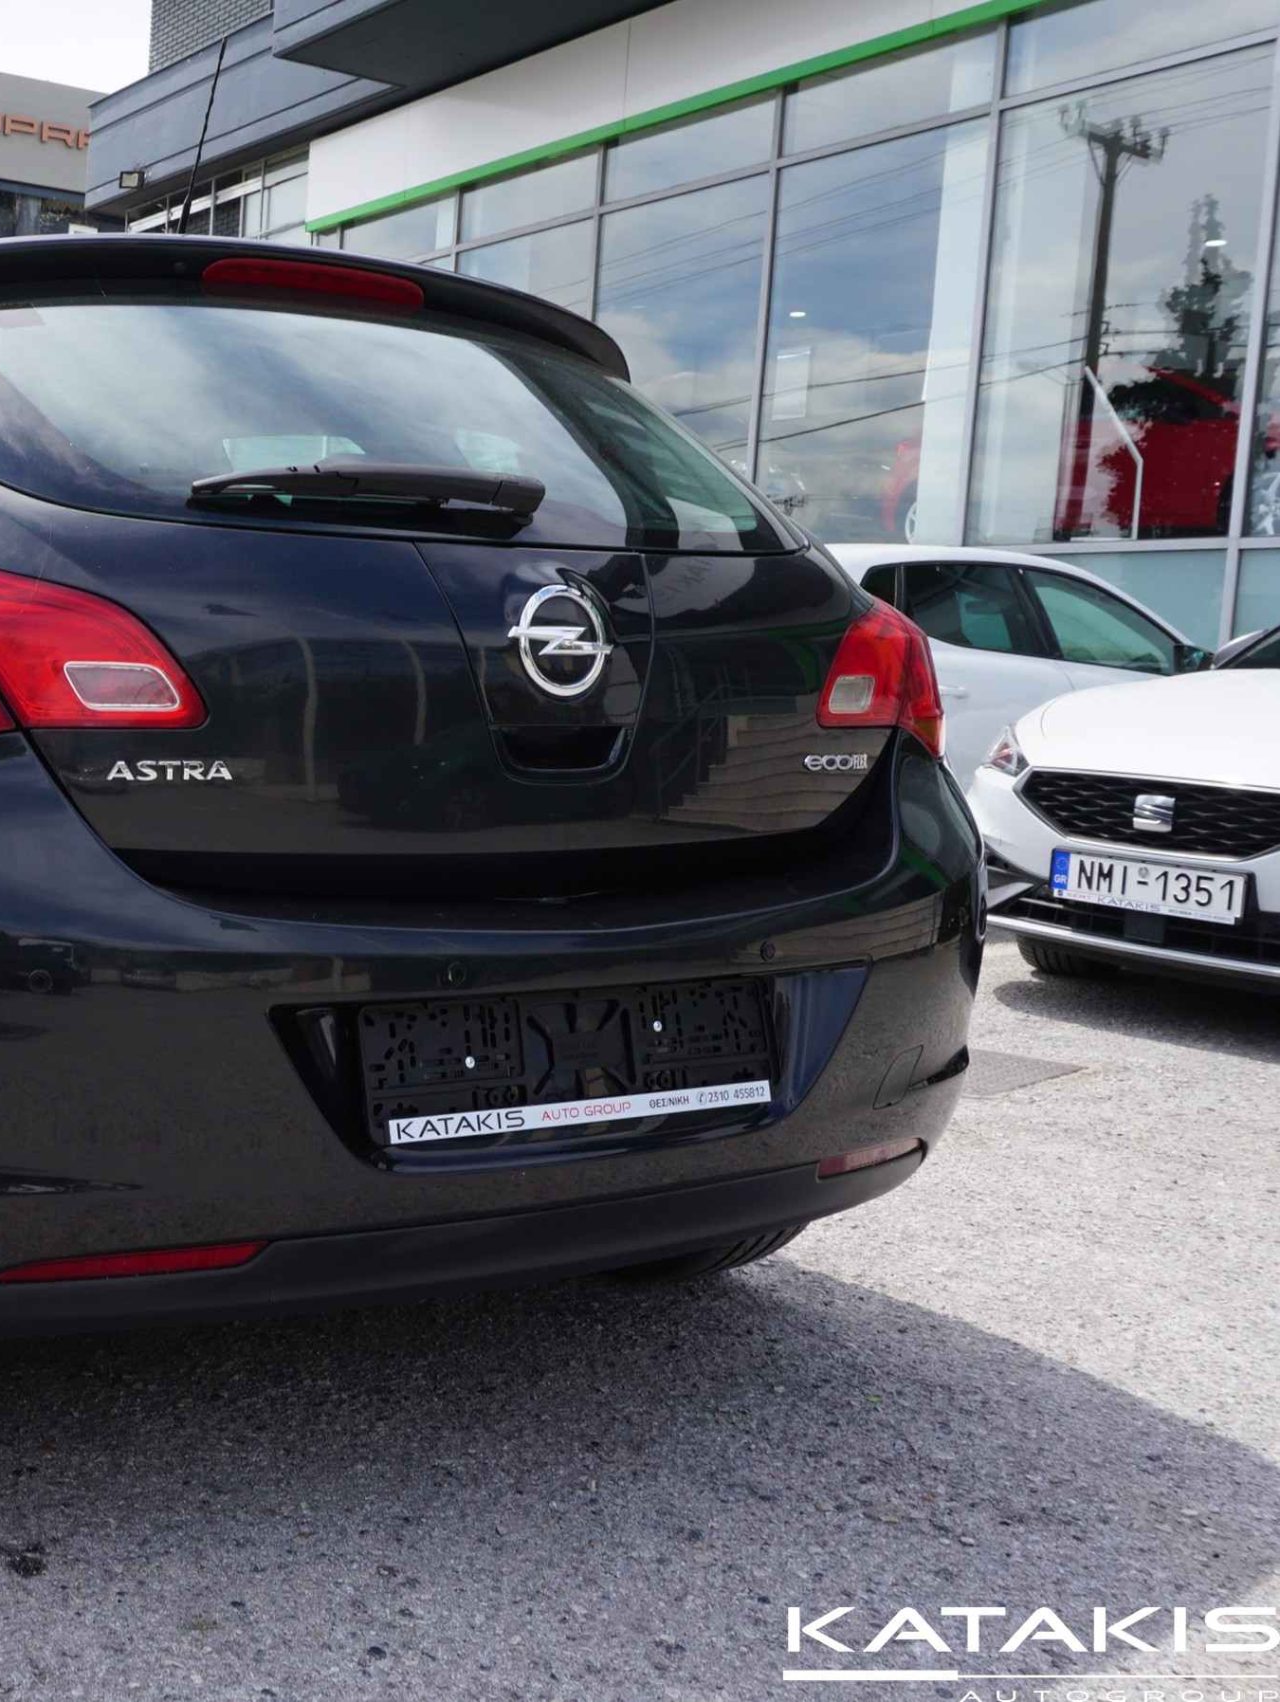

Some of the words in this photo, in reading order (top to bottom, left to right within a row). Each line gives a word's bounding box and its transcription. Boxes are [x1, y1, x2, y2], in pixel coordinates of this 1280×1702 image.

[106, 760, 233, 781] ASTRA
[708, 1089, 730, 1103] 2310
[733, 1086, 766, 1100] 455812
[396, 1110, 525, 1140] KATAKIS
[541, 1107, 580, 1121] AUTO
[583, 1101, 632, 1117] GROUP
